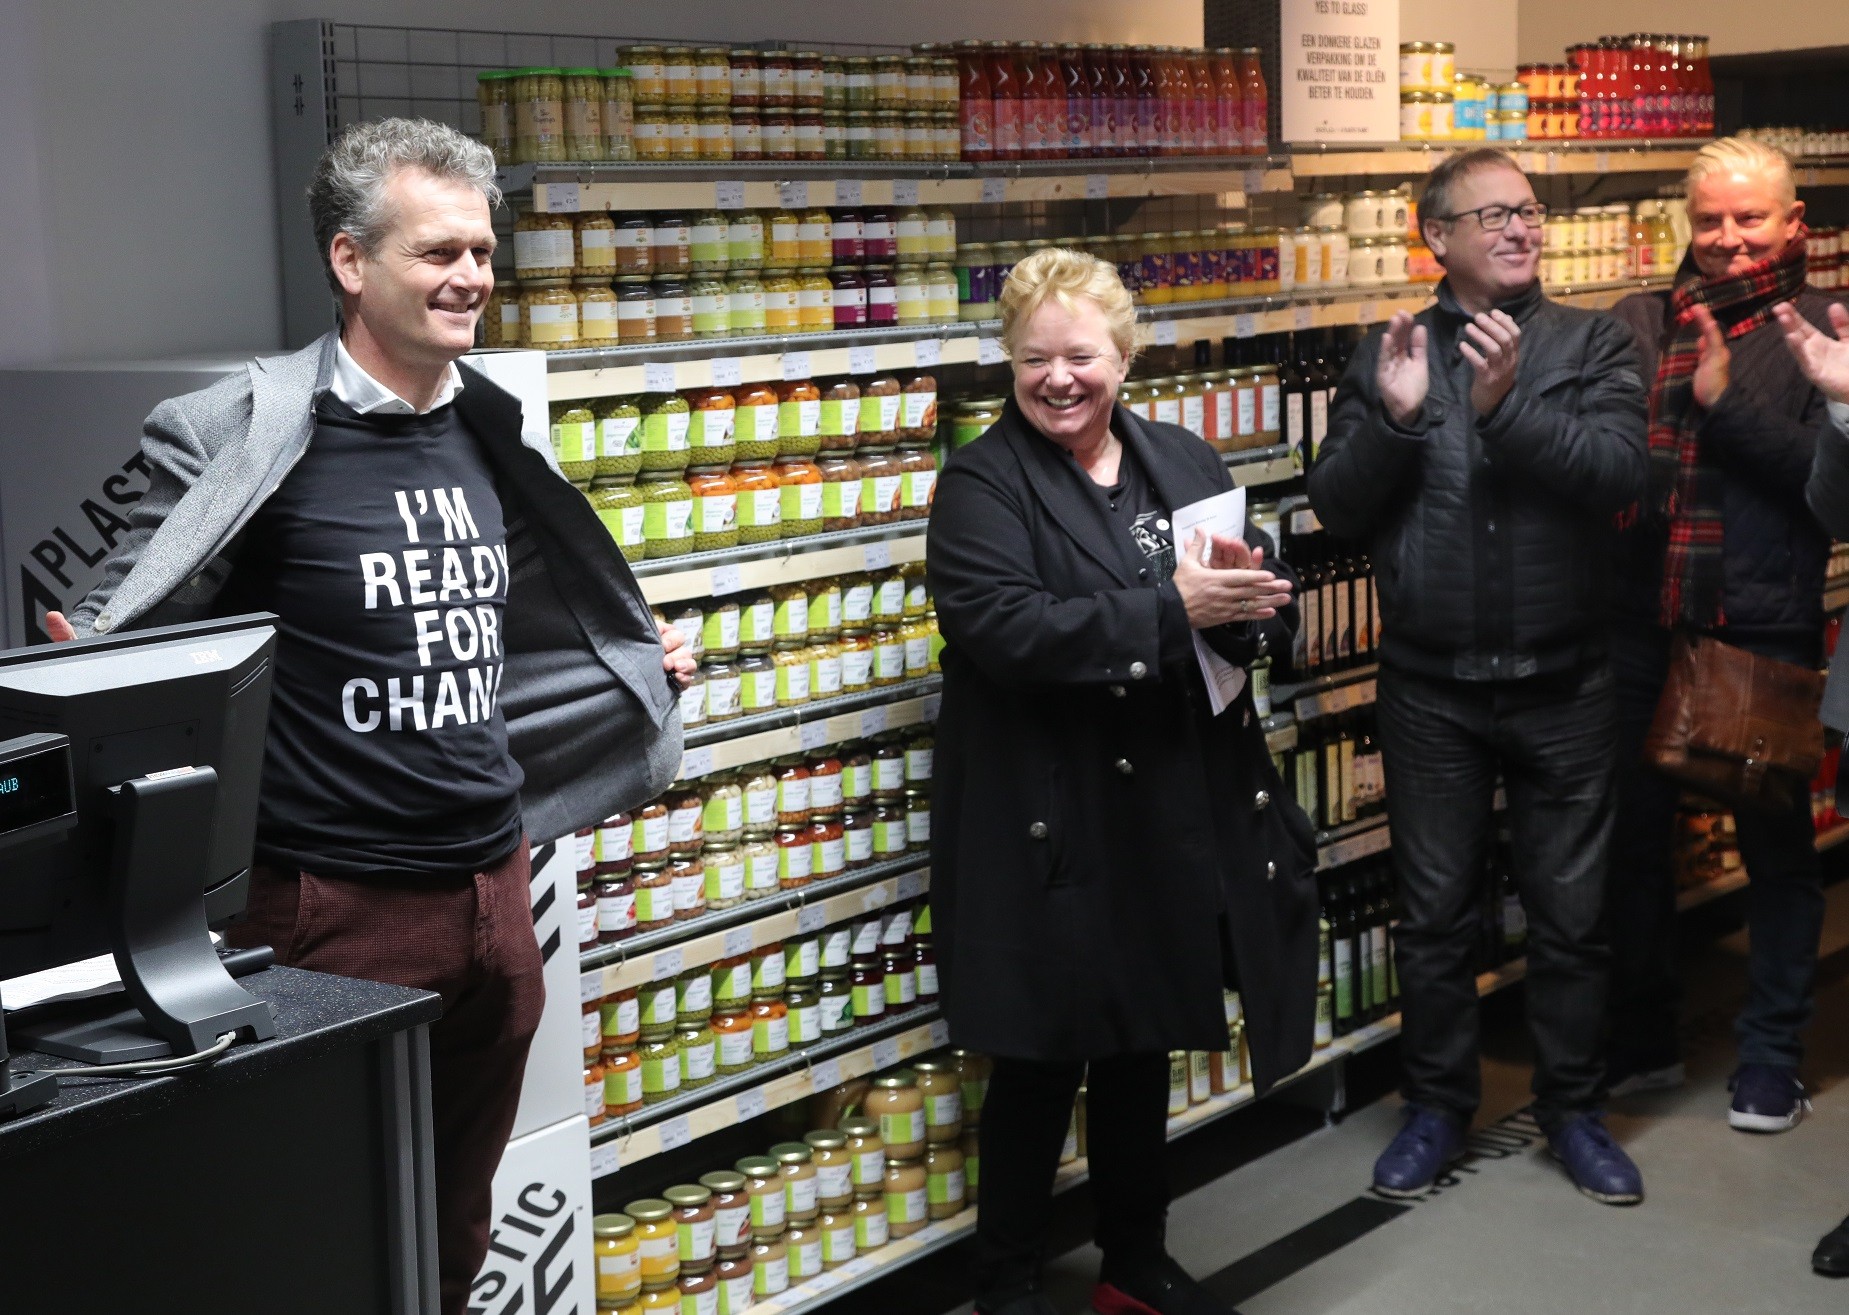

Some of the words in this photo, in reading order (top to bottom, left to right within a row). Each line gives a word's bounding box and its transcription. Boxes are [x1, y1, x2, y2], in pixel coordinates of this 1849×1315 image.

[1315, 0, 1329, 14] YES
[1331, 1, 1341, 15] TO
[1301, 34, 1316, 48] EEN
[1354, 36, 1381, 50] GLAZEN
[1306, 52, 1352, 65] VERPAKKING
[1368, 53, 1377, 66] DE
[1297, 68, 1335, 82] KWALITEIT
[1338, 69, 1352, 82] VAN
[1354, 70, 1363, 82] DE
[1309, 86, 1332, 99] BETER
[1334, 86, 1342, 99] TE
[29, 449, 152, 590] PLAST
[394, 487, 480, 542] I'M
[359, 544, 509, 609] READY
[413, 603, 499, 667] FOR
[189, 649, 223, 665] IBM
[341, 663, 504, 733] CHAN
